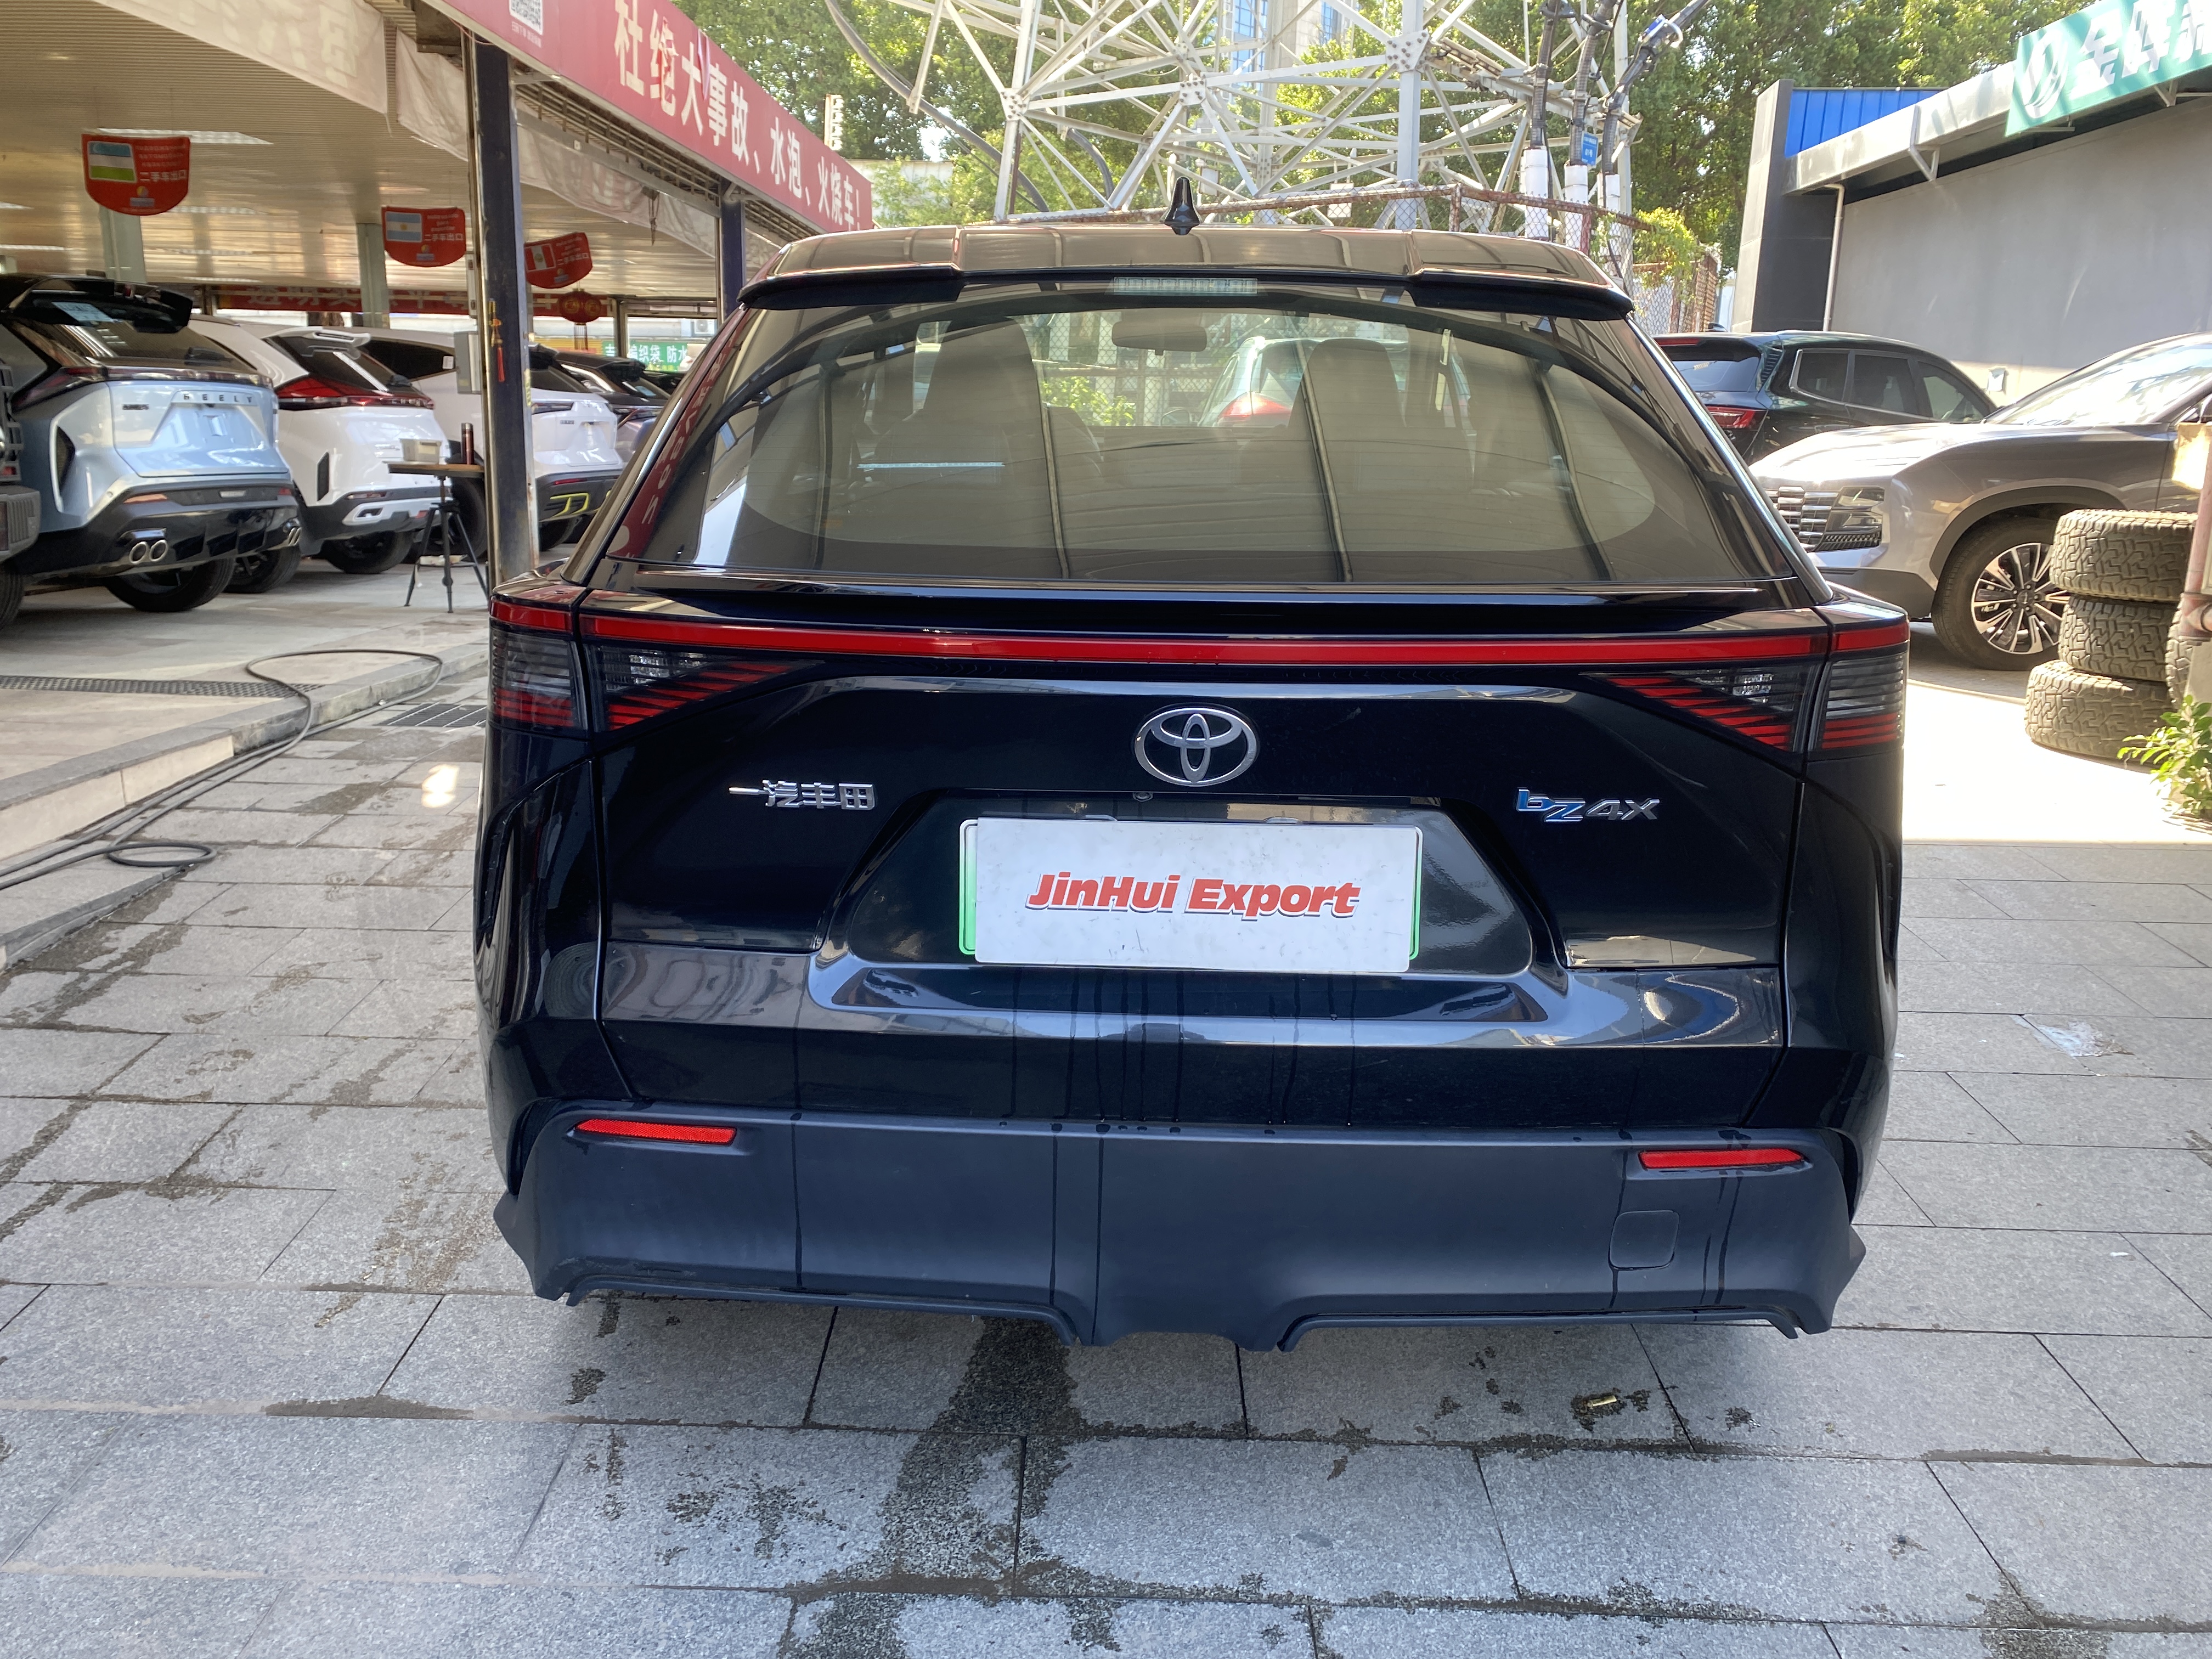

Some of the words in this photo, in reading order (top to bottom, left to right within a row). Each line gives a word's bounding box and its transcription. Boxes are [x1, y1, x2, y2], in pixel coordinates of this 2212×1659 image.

[729, 779, 876, 810] 一汽丰田
[1025, 871, 1181, 913] JinHui
[1184, 878, 1361, 922] Export
